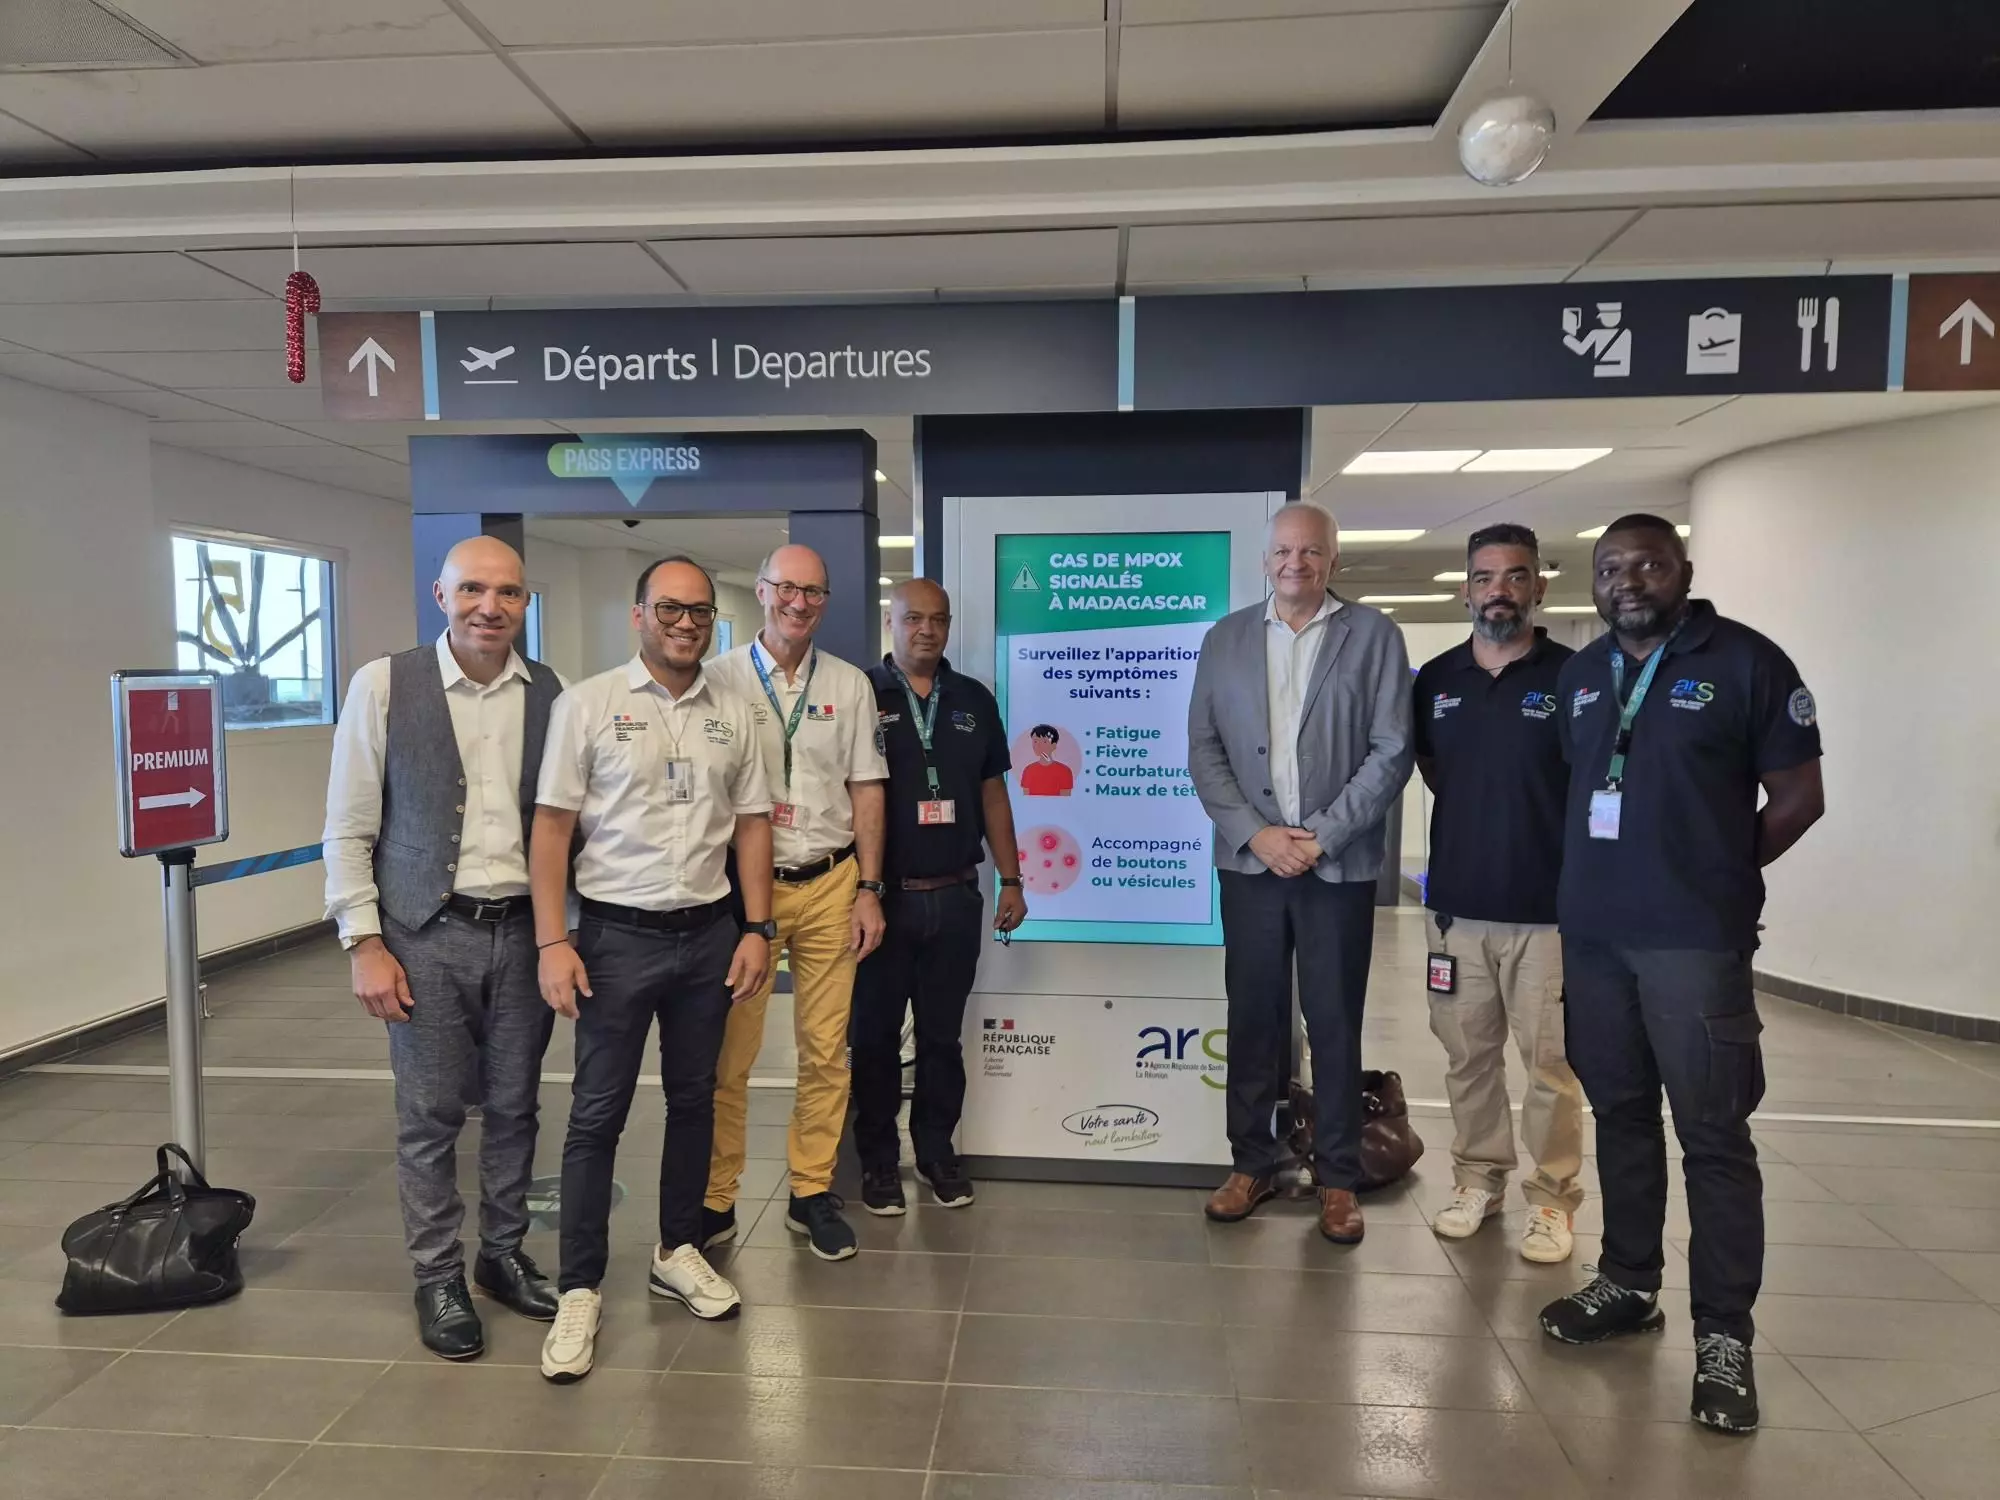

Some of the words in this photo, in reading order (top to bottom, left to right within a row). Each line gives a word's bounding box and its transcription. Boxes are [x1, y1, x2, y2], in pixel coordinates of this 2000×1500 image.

[543, 344, 697, 390] Départs
[733, 343, 932, 388] Departures
[564, 448, 613, 473] PASS
[616, 446, 701, 471] EXPRESS
[1049, 552, 1088, 568] CAS
[1093, 553, 1120, 568] DE
[1125, 552, 1184, 568] MPOX
[1049, 570, 1143, 589] SIGNALÉS
[1048, 592, 1064, 610] À
[1068, 595, 1207, 610] MADAGASCAR
[1018, 647, 1100, 661] Surveillez
[1043, 667, 1073, 680] des
[1077, 667, 1178, 683] symptômes
[1069, 686, 1141, 699] suivants
[704, 718, 734, 738] ars
[1096, 726, 1161, 742] Fatigue
[1096, 745, 1148, 758] Fièvre
[132, 748, 209, 772] PREMIUM
[1095, 764, 1192, 778] Courbature
[1095, 784, 1141, 796] Maux
[1146, 784, 1168, 796] de
[1173, 783, 1198, 797] têt
[1092, 837, 1202, 853] Accompagné
[1092, 855, 1112, 869] de
[1117, 855, 1187, 869] boutons
[1092, 876, 1114, 888] ou
[1119, 873, 1196, 889] vésicules
[983, 1032, 1056, 1045] RÉPUBLIQUE
[983, 1044, 1051, 1055] FRANÇAISE
[1150, 1061, 1170, 1071] Agence
[1144, 1070, 1168, 1079] Réunion
[1080, 1114, 1109, 1130] Votre
[1111, 1111, 1147, 1127] santé
